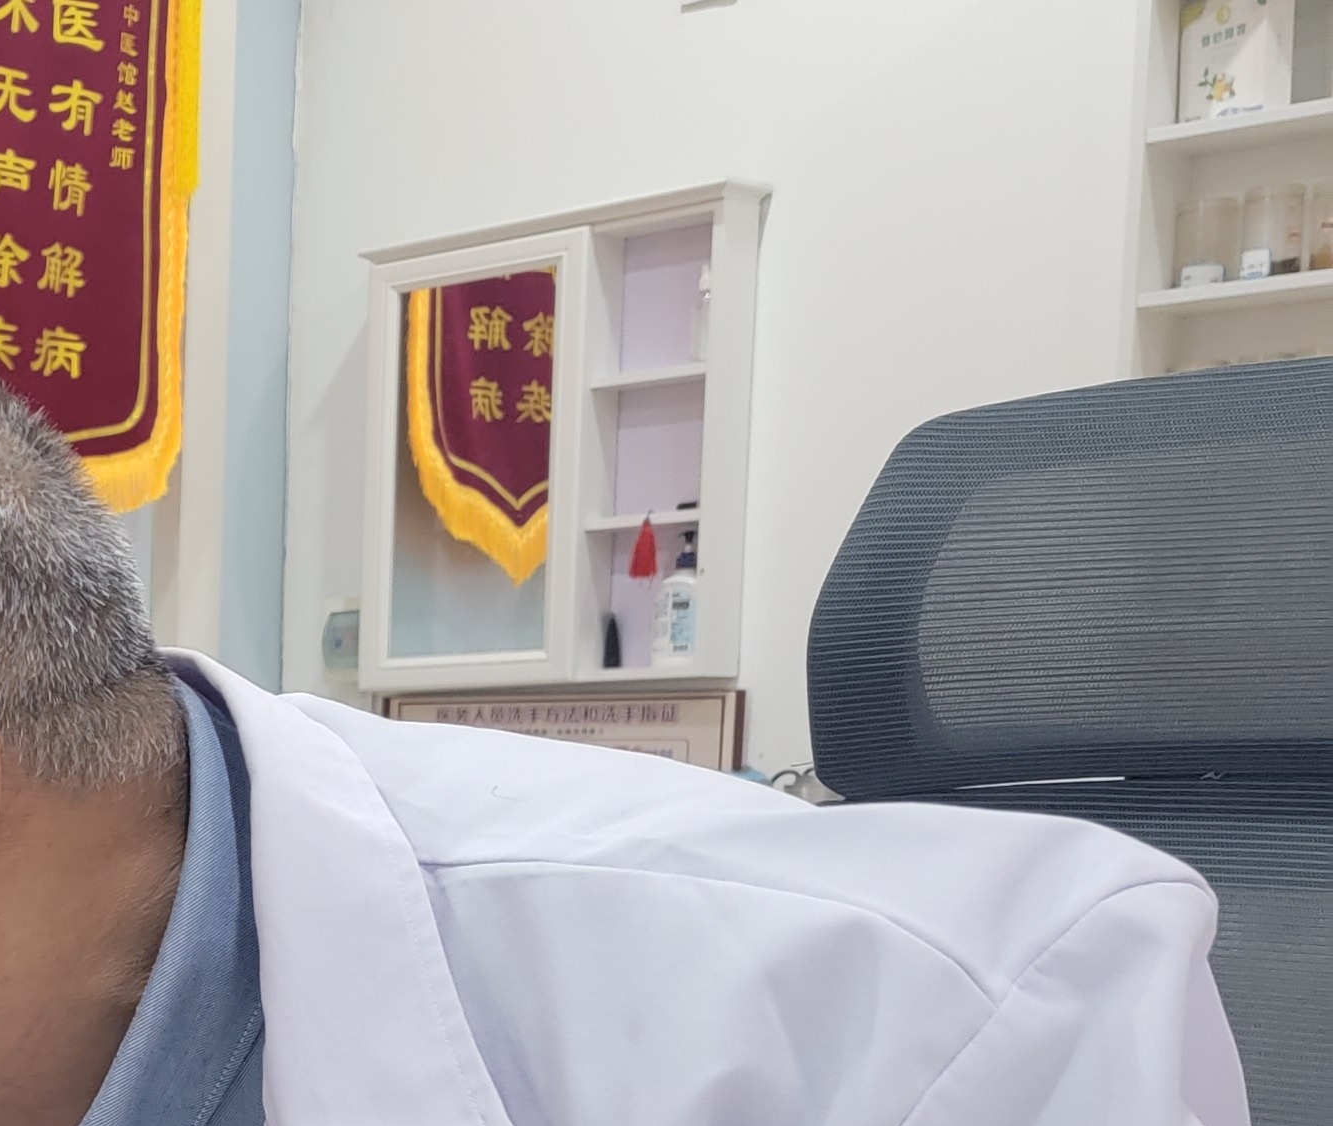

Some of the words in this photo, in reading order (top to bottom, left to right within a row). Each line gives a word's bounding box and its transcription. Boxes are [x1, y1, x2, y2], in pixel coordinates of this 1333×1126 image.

[29, 0, 105, 380] 医有情解病
[109, 4, 139, 170] 中医馆赵老师
